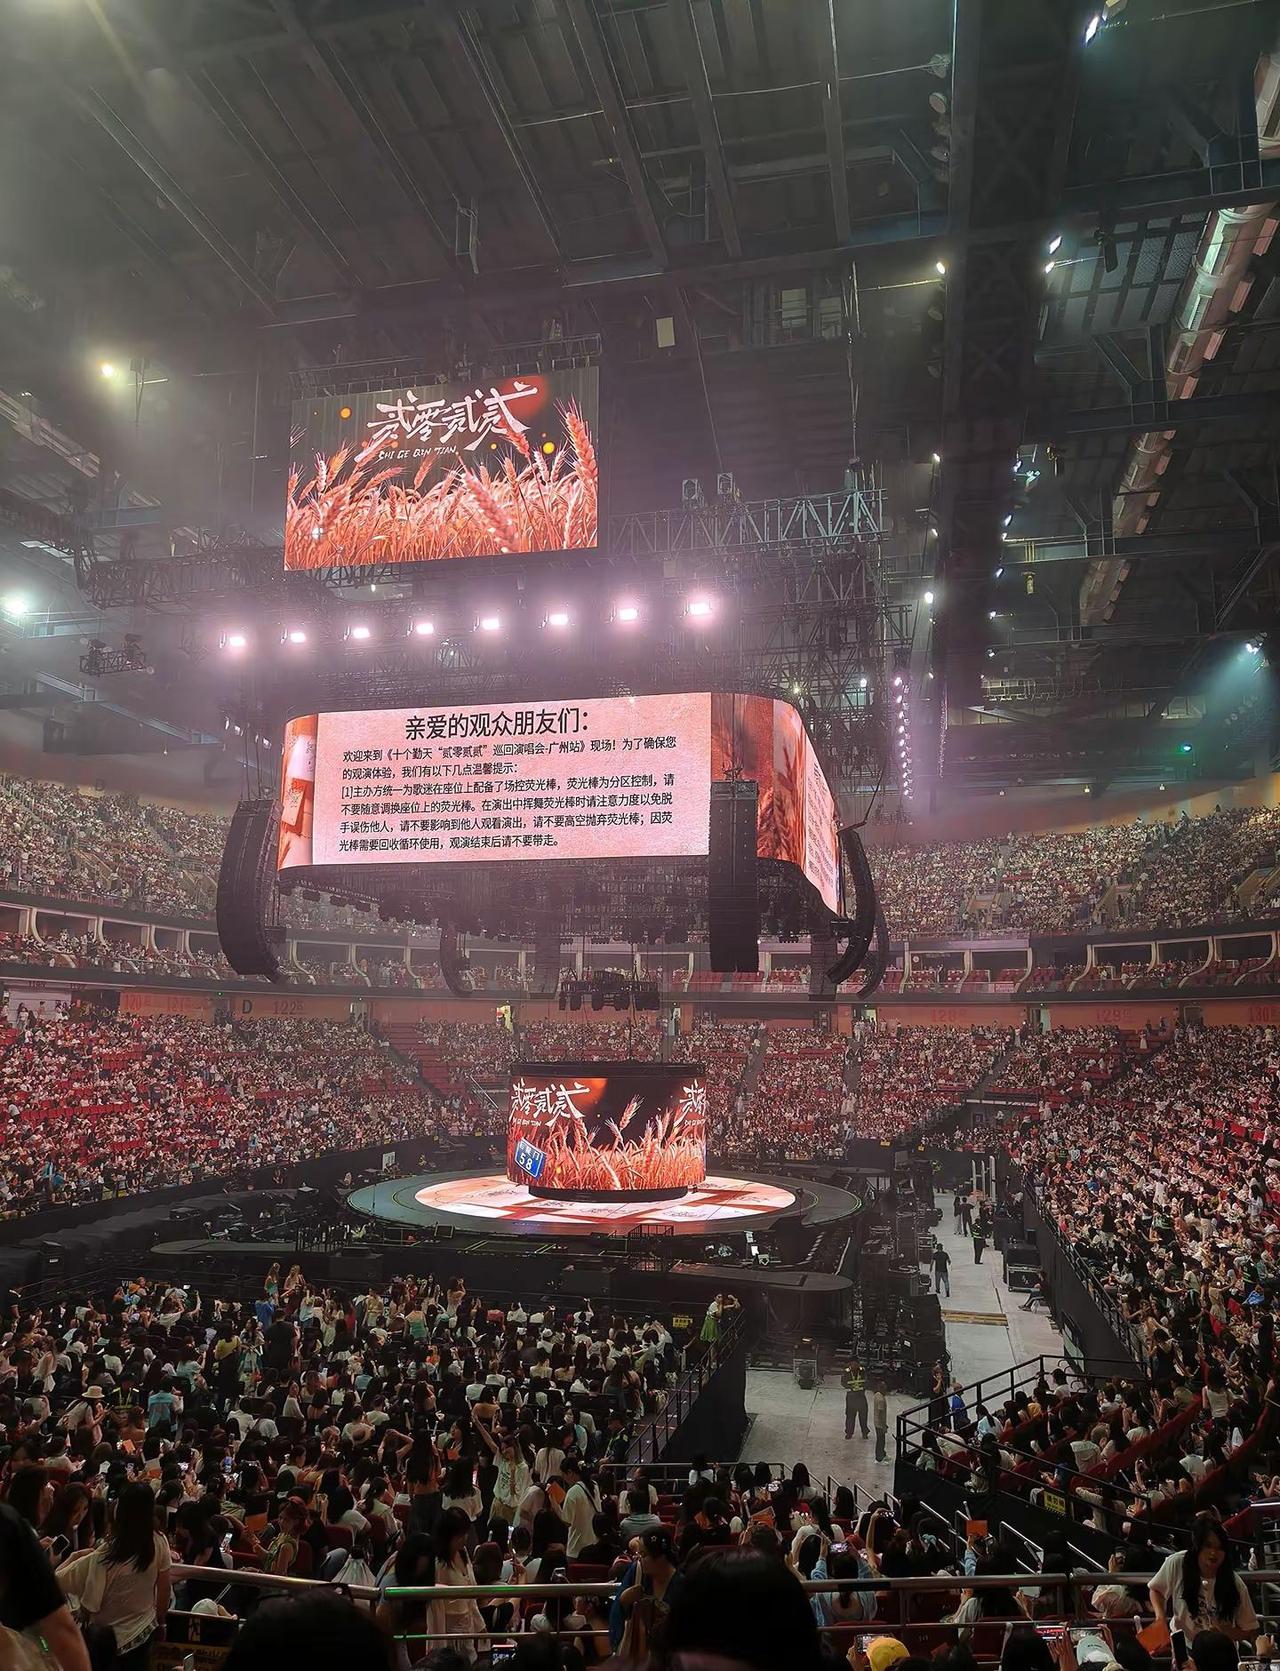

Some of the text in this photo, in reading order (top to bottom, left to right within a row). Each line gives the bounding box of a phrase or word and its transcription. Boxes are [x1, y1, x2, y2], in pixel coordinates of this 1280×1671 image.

[354, 381, 538, 463] 贰零贰贰
[405, 707, 588, 741] 亲爱的观众朋友们：
[519, 1153, 533, 1170] 58
